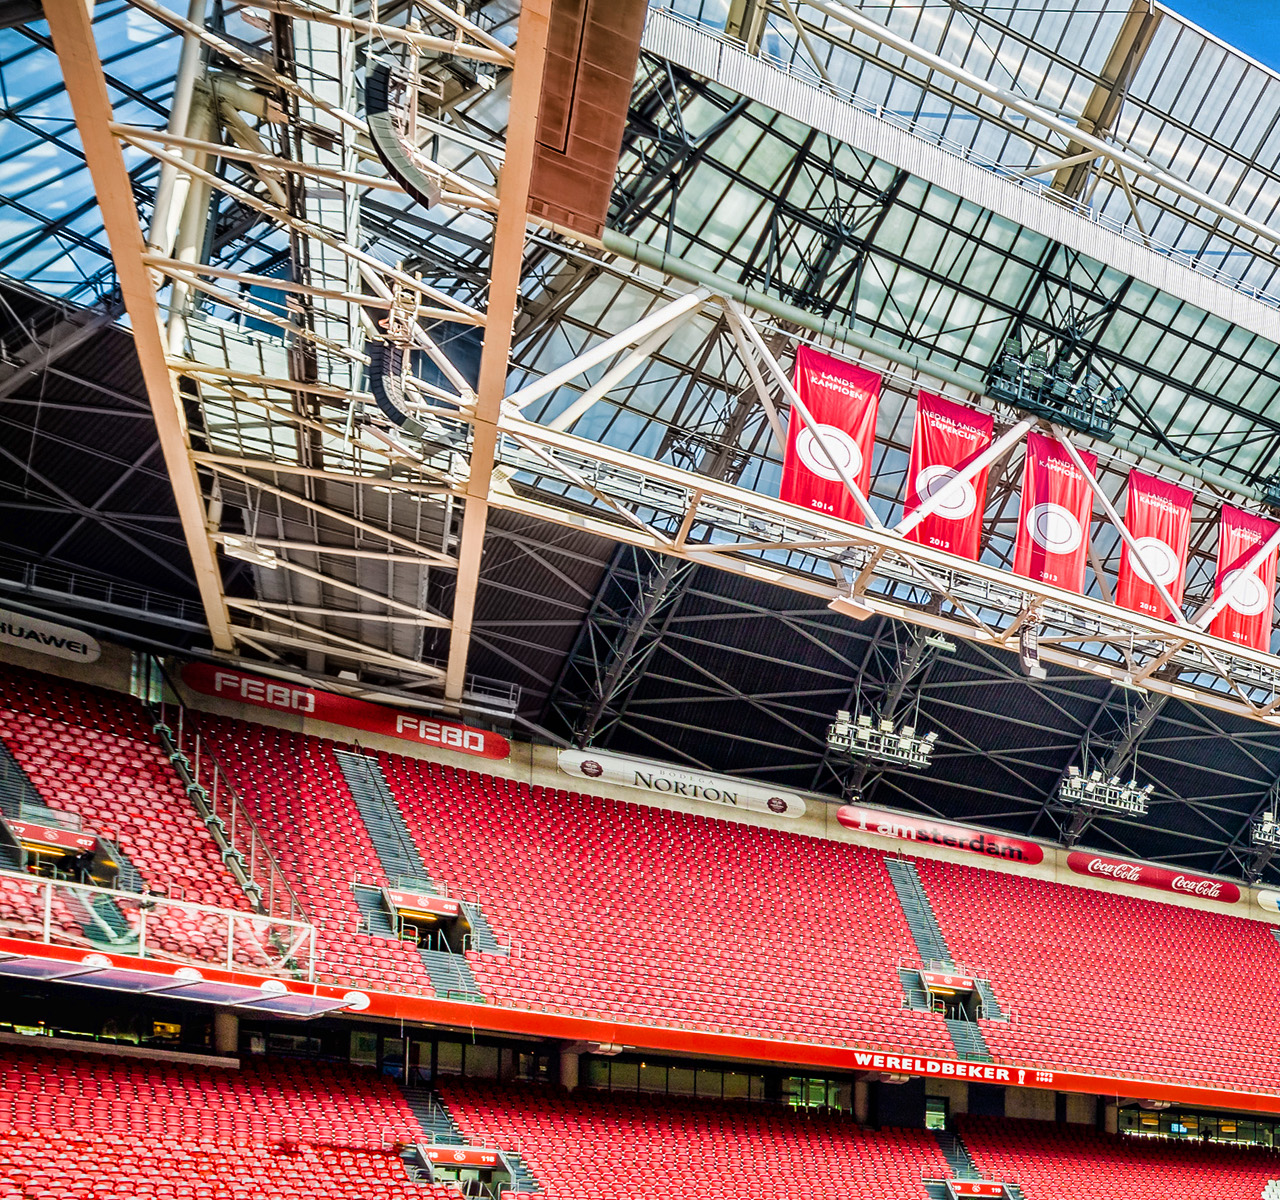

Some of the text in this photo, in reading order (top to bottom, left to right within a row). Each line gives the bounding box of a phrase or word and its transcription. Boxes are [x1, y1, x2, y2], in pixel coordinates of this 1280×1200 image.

[810, 376, 862, 401] KAMPIOEN
[821, 371, 854, 388] LANDS
[922, 408, 986, 437] NEDERLANDSE
[930, 420, 976, 441] SUPERCUP
[1039, 460, 1082, 481] KAMPIOEN
[1047, 455, 1075, 469] LANDS
[812, 499, 834, 512] 2014
[1139, 496, 1179, 515] KAMPIOEN
[1147, 491, 1172, 505] LANDS
[929, 536, 950, 549] 2013
[1039, 570, 1058, 582] 2013
[1139, 601, 1157, 613] 2012
[1232, 631, 1248, 641] 2011
[214, 672, 315, 713] FEBO
[396, 715, 484, 752] FEBO
[659, 769, 714, 786] BODEGA
[633, 770, 739, 806] NORTON
[858, 811, 868, 830] I
[854, 1052, 1010, 1081] WERELDBEKER
